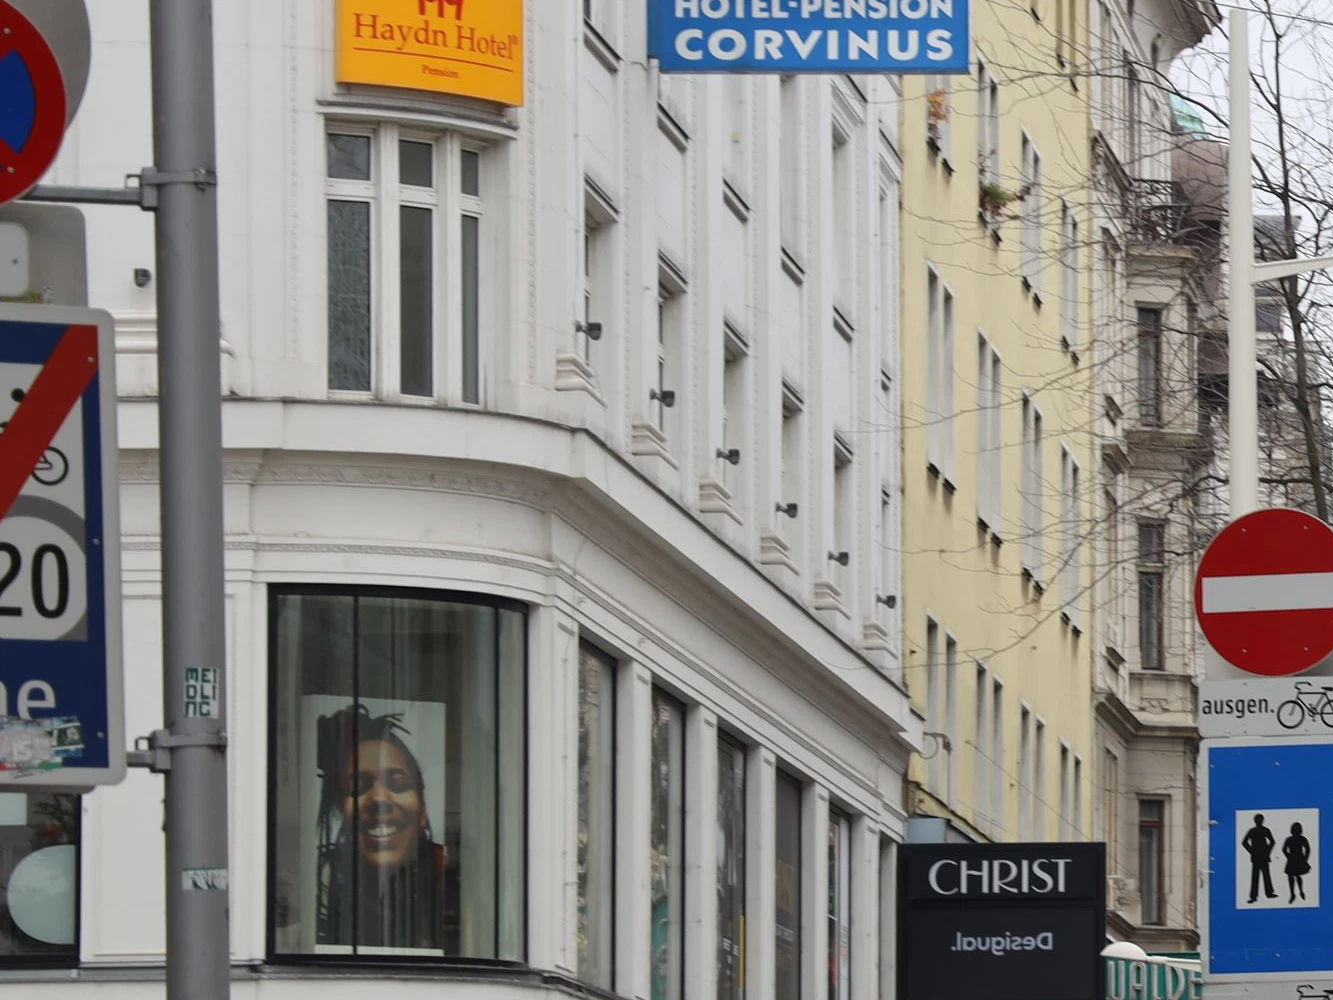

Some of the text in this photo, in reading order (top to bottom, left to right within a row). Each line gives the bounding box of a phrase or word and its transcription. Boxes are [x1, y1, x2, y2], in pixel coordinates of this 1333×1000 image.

[352, 13, 448, 51] Haydn
[674, 28, 954, 62] CORVINUS
[1202, 696, 1275, 719] ausgen.
[928, 858, 1073, 896] CHRIST
